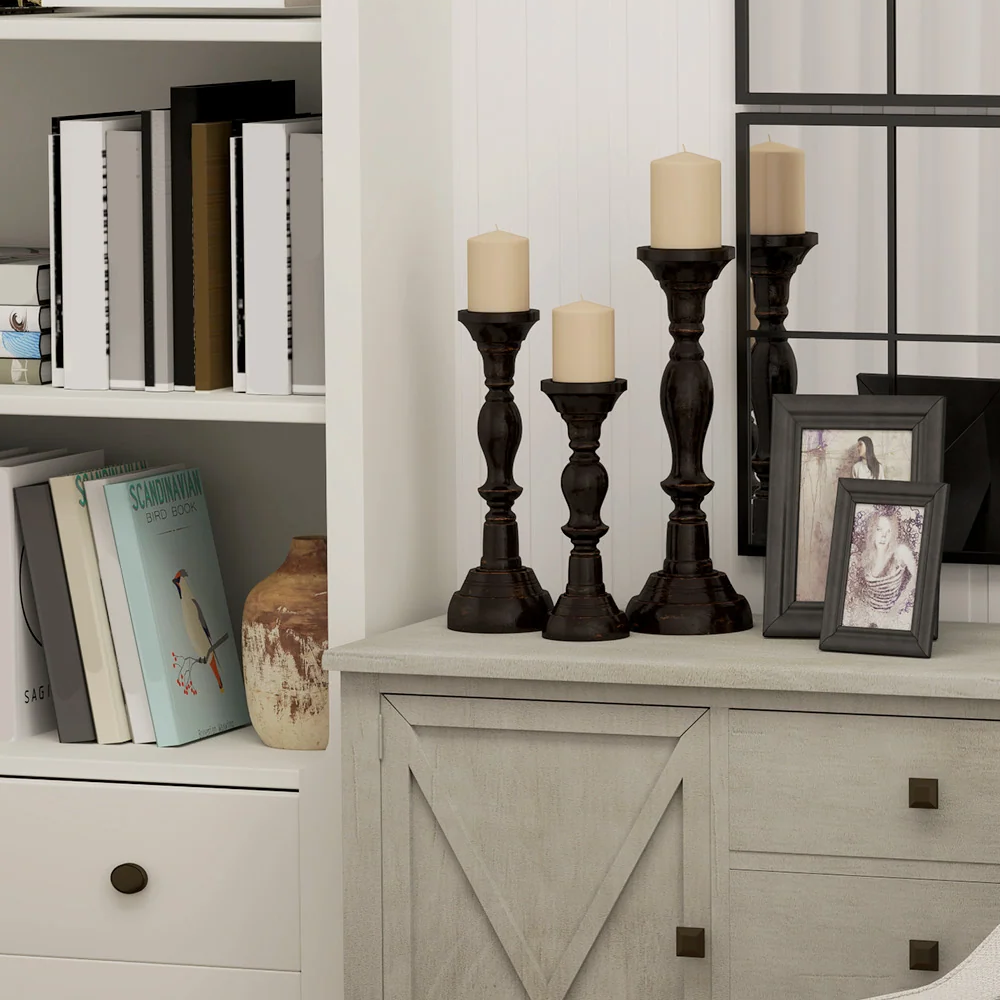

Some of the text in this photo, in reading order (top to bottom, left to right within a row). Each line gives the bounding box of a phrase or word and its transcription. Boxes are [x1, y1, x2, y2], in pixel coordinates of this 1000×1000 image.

[129, 468, 202, 511] SCANDINAVIAN
[145, 501, 197, 523] BIRD BOOK
